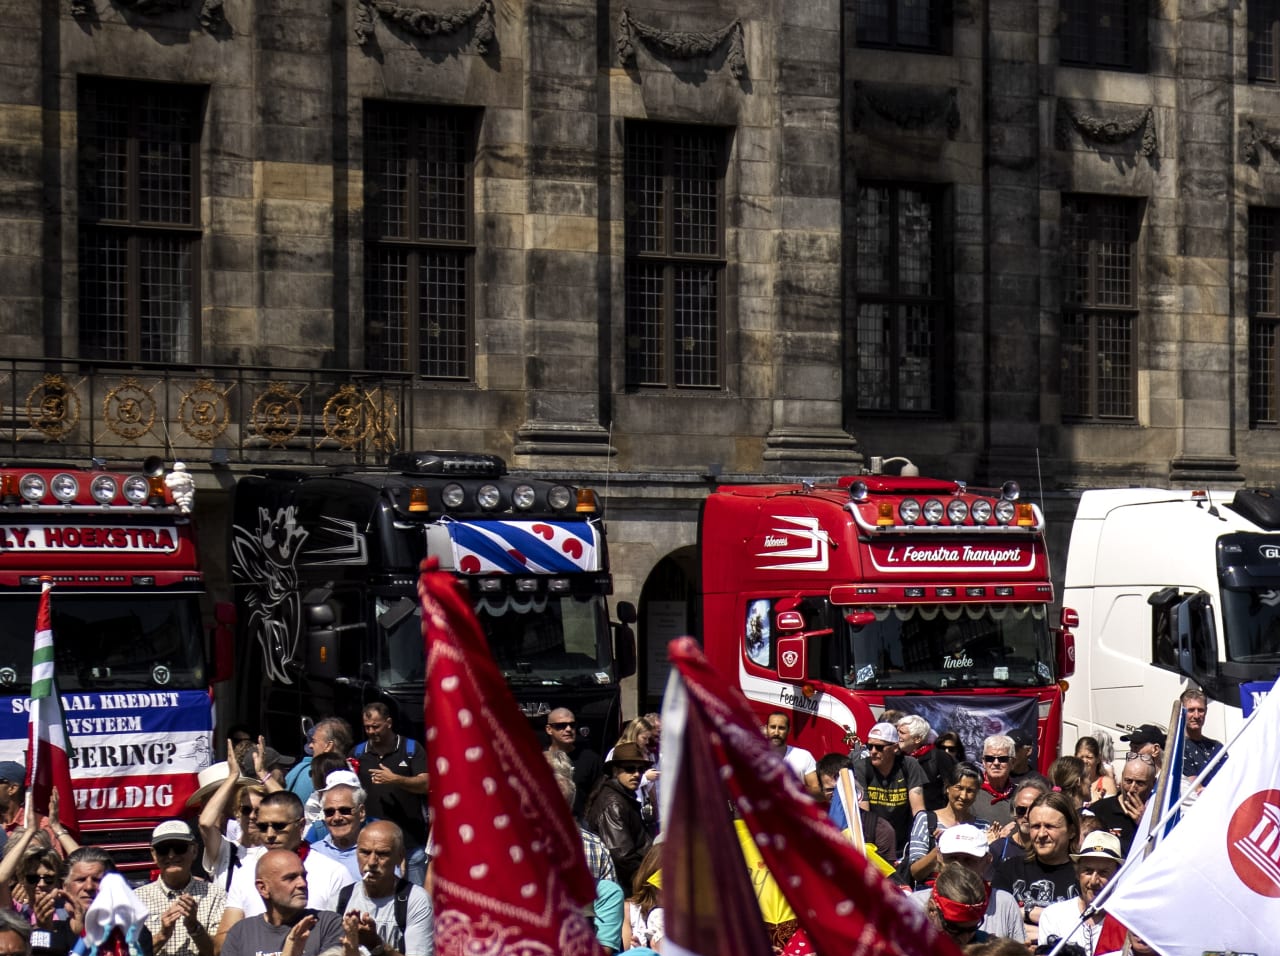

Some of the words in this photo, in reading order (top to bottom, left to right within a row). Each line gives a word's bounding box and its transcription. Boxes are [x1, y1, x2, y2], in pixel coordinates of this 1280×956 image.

[44, 528, 174, 549] HOEKSTRA
[887, 547, 899, 562] L.
[903, 546, 960, 562] Feenstra
[962, 546, 1021, 566] Transport
[944, 655, 974, 669] Tineke
[100, 692, 179, 709] KREDIET
[780, 686, 818, 711] Feenstra
[66, 742, 177, 770] GERING?
[73, 784, 173, 810] HULDIG
